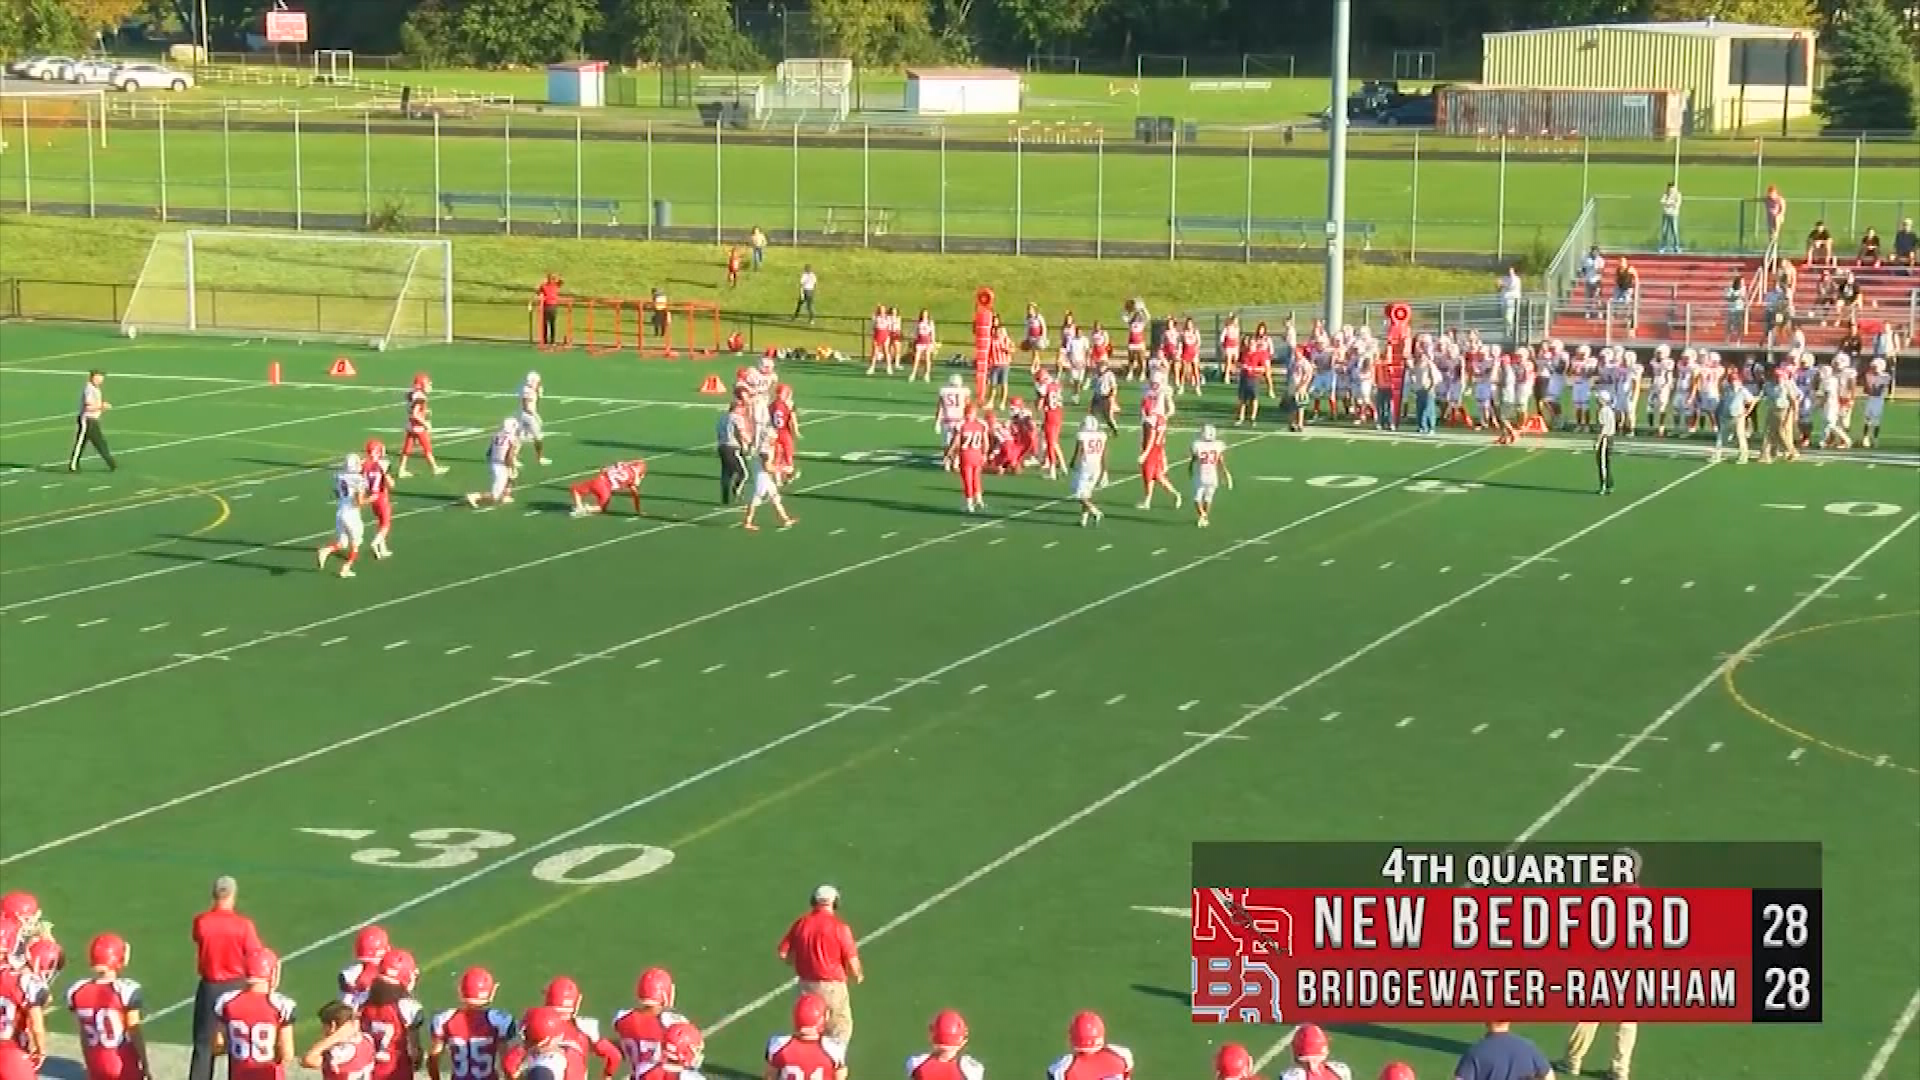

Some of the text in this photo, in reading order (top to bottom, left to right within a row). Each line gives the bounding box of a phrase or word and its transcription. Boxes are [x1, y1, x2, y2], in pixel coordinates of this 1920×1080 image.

[961, 431, 982, 449] 70
[77, 1007, 126, 1049] 50
[229, 1019, 277, 1063] 68
[452, 1036, 495, 1079] 35
